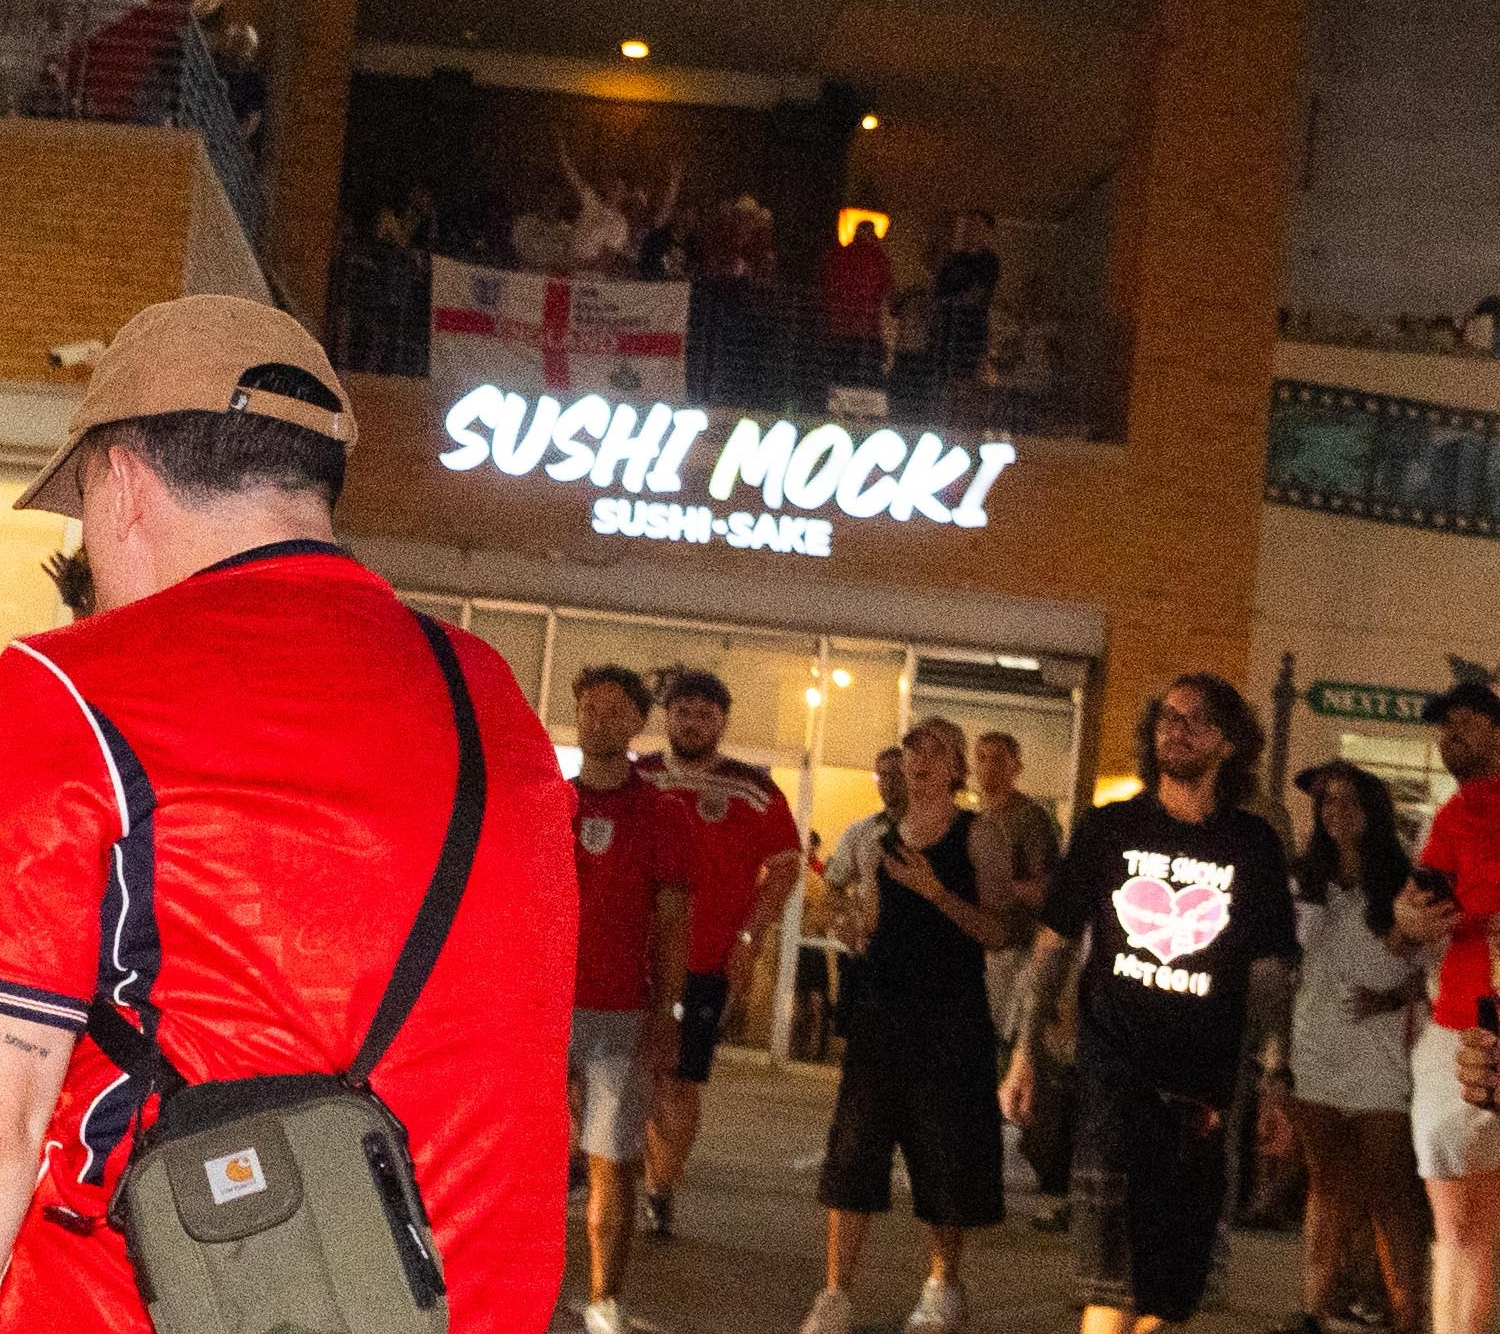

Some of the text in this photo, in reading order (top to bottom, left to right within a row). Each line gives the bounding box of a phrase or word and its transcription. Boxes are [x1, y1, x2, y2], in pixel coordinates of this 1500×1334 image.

[440, 384, 1017, 529] SUSHI MOCKI
[1122, 850, 1171, 879] THE
